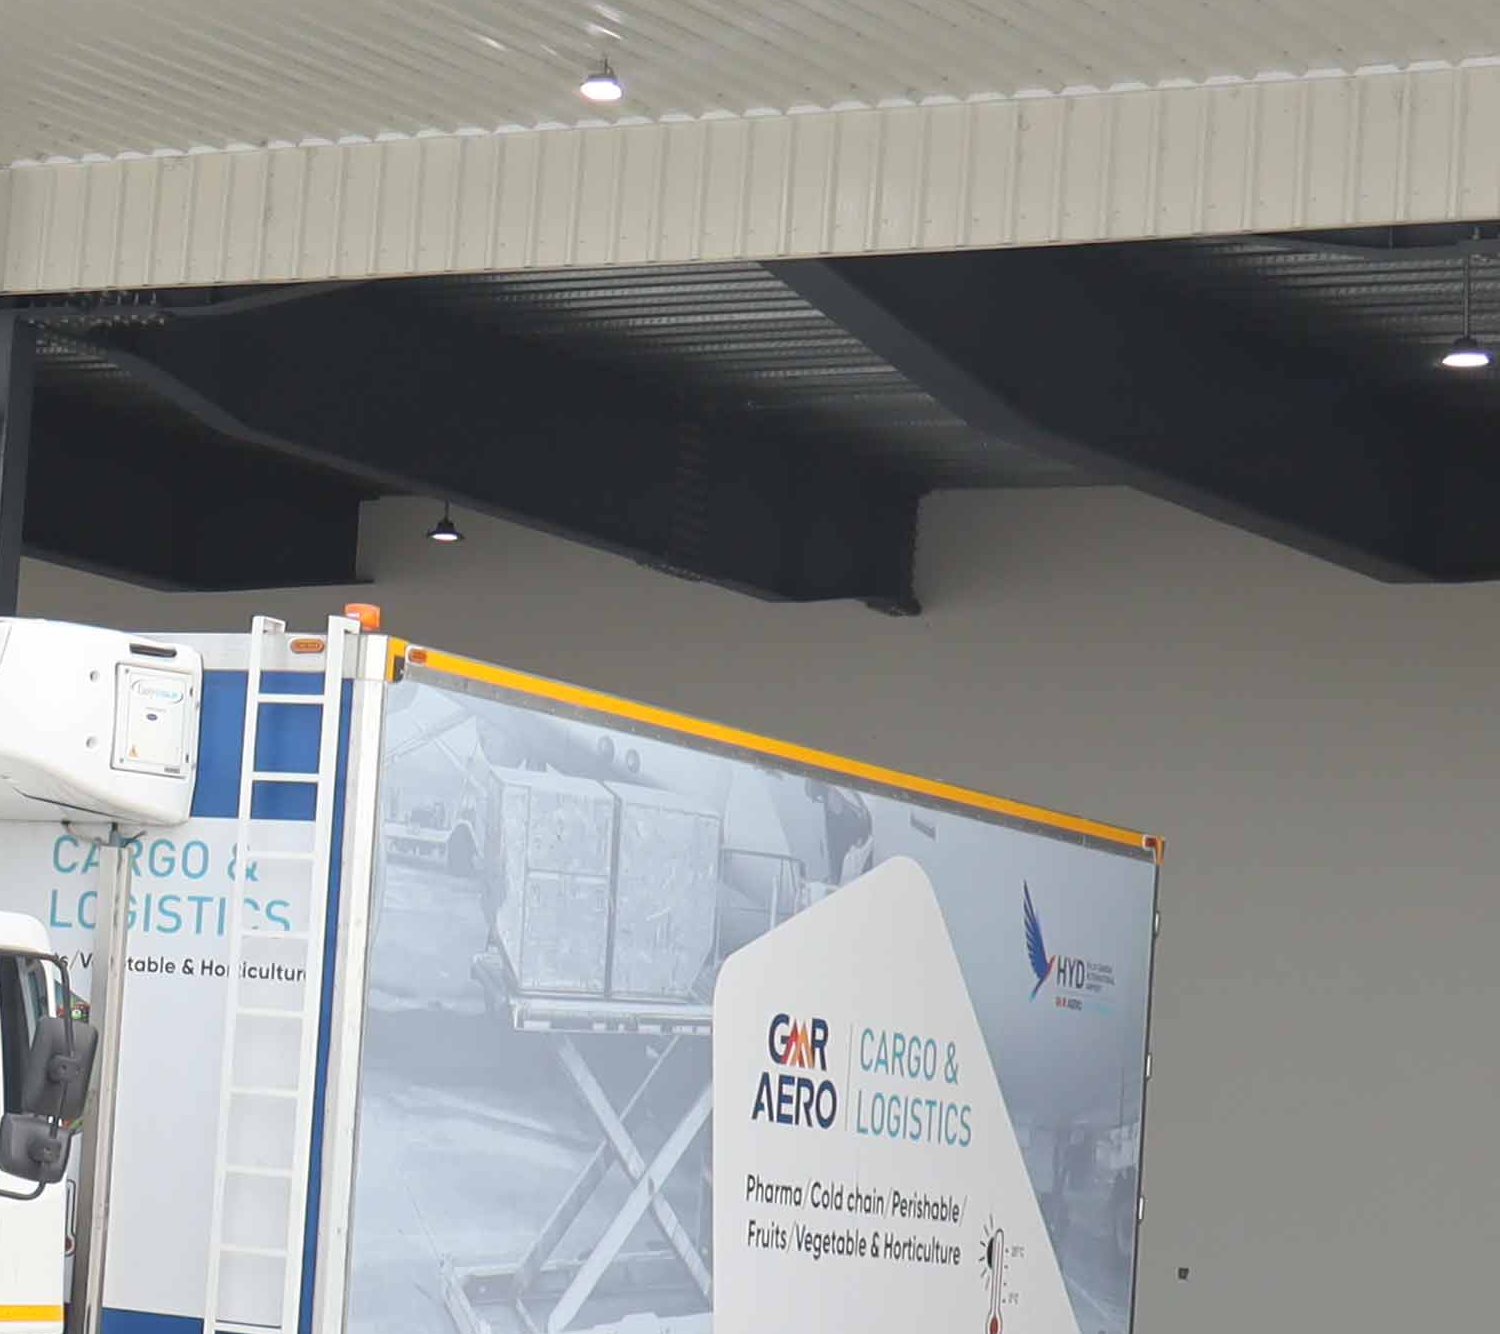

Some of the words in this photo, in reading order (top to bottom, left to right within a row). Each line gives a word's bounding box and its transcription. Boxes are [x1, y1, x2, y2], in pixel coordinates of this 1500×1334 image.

[182, 958, 194, 976] &
[1056, 954, 1085, 989] HYD
[768, 1013, 829, 1072] GMR
[859, 1027, 938, 1081] CARGO
[943, 1041, 959, 1085] &
[751, 1071, 838, 1130] AERO
[856, 1089, 973, 1148] LOGISTICS
[870, 1231, 880, 1259] &
[883, 1232, 961, 1266] Horticulture
